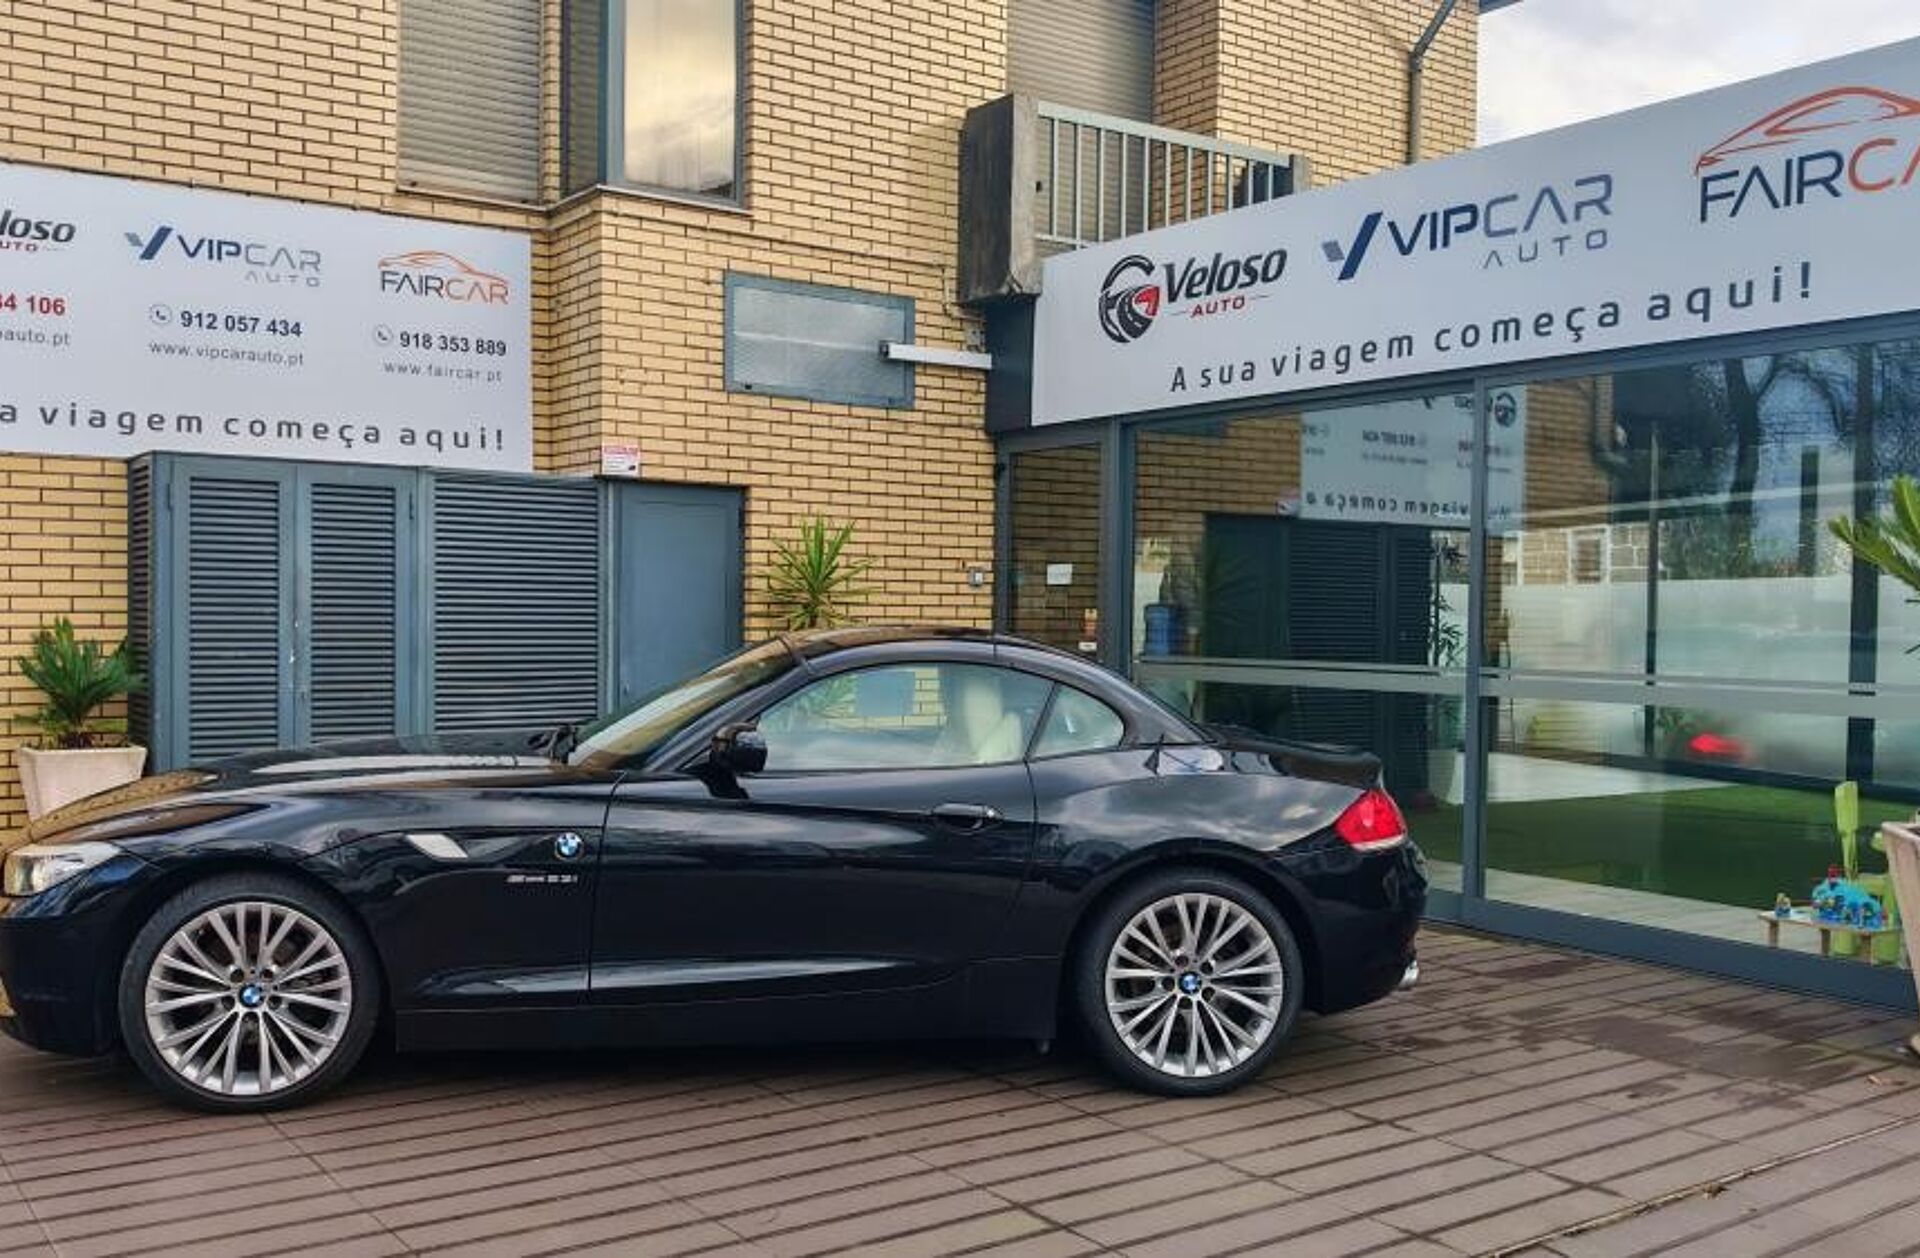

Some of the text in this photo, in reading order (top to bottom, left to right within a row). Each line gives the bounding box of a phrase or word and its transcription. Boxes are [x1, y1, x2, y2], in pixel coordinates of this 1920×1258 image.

[1387, 174, 1614, 257] VIPCAR
[177, 234, 321, 272] VIPCAR
[1483, 229, 1608, 269] AUTO
[245, 270, 321, 288] AUTO
[380, 269, 509, 305] FAIRCAR
[1165, 248, 1288, 303] Veloso
[26, 295, 66, 316] 106
[1191, 296, 1246, 318] AUTO
[181, 310, 302, 337] 912 057 434
[1170, 261, 1811, 392] A sua viagem começa aqui!
[149, 342, 304, 366] www.vipcarauto.pt
[400, 331, 433, 349] 918
[438, 335, 470, 352] 353
[383, 362, 502, 382] www.faircar.pt
[39, 402, 202, 435] viagem
[223, 418, 380, 448] começa
[400, 427, 503, 452] aqui!
